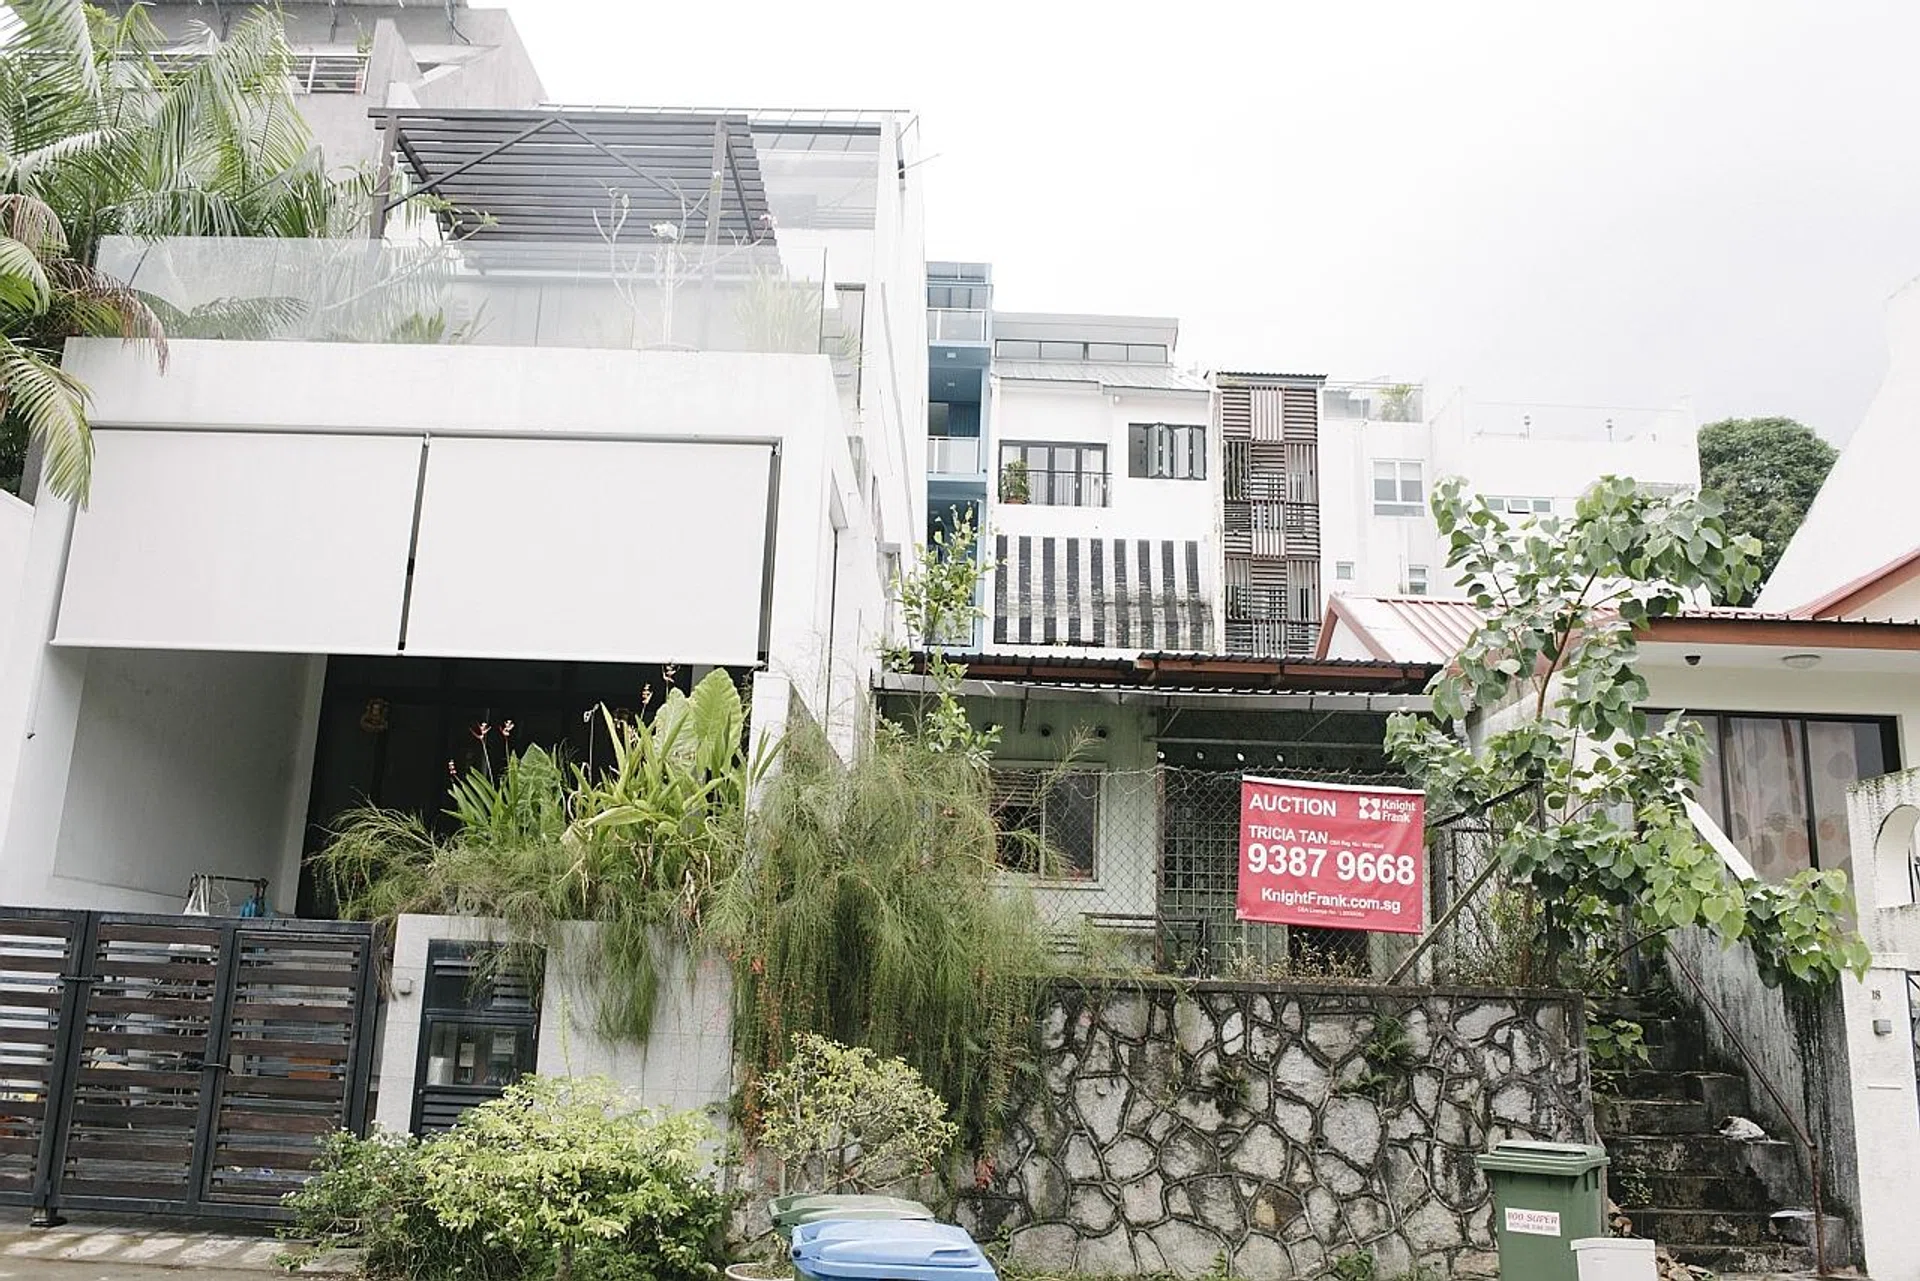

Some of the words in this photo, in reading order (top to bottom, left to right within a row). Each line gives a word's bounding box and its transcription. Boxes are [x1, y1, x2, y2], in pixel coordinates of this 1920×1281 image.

[1249, 793, 1336, 818] AUCTION
[1382, 799, 1416, 813] Knight
[1382, 812, 1411, 823] Frank
[1248, 825, 1296, 842] TRICIA
[1299, 829, 1329, 845] TAN
[1247, 843, 1328, 878] 9387
[1336, 850, 1416, 886] 9668
[1261, 887, 1401, 914] KnightFrank.com.sg
